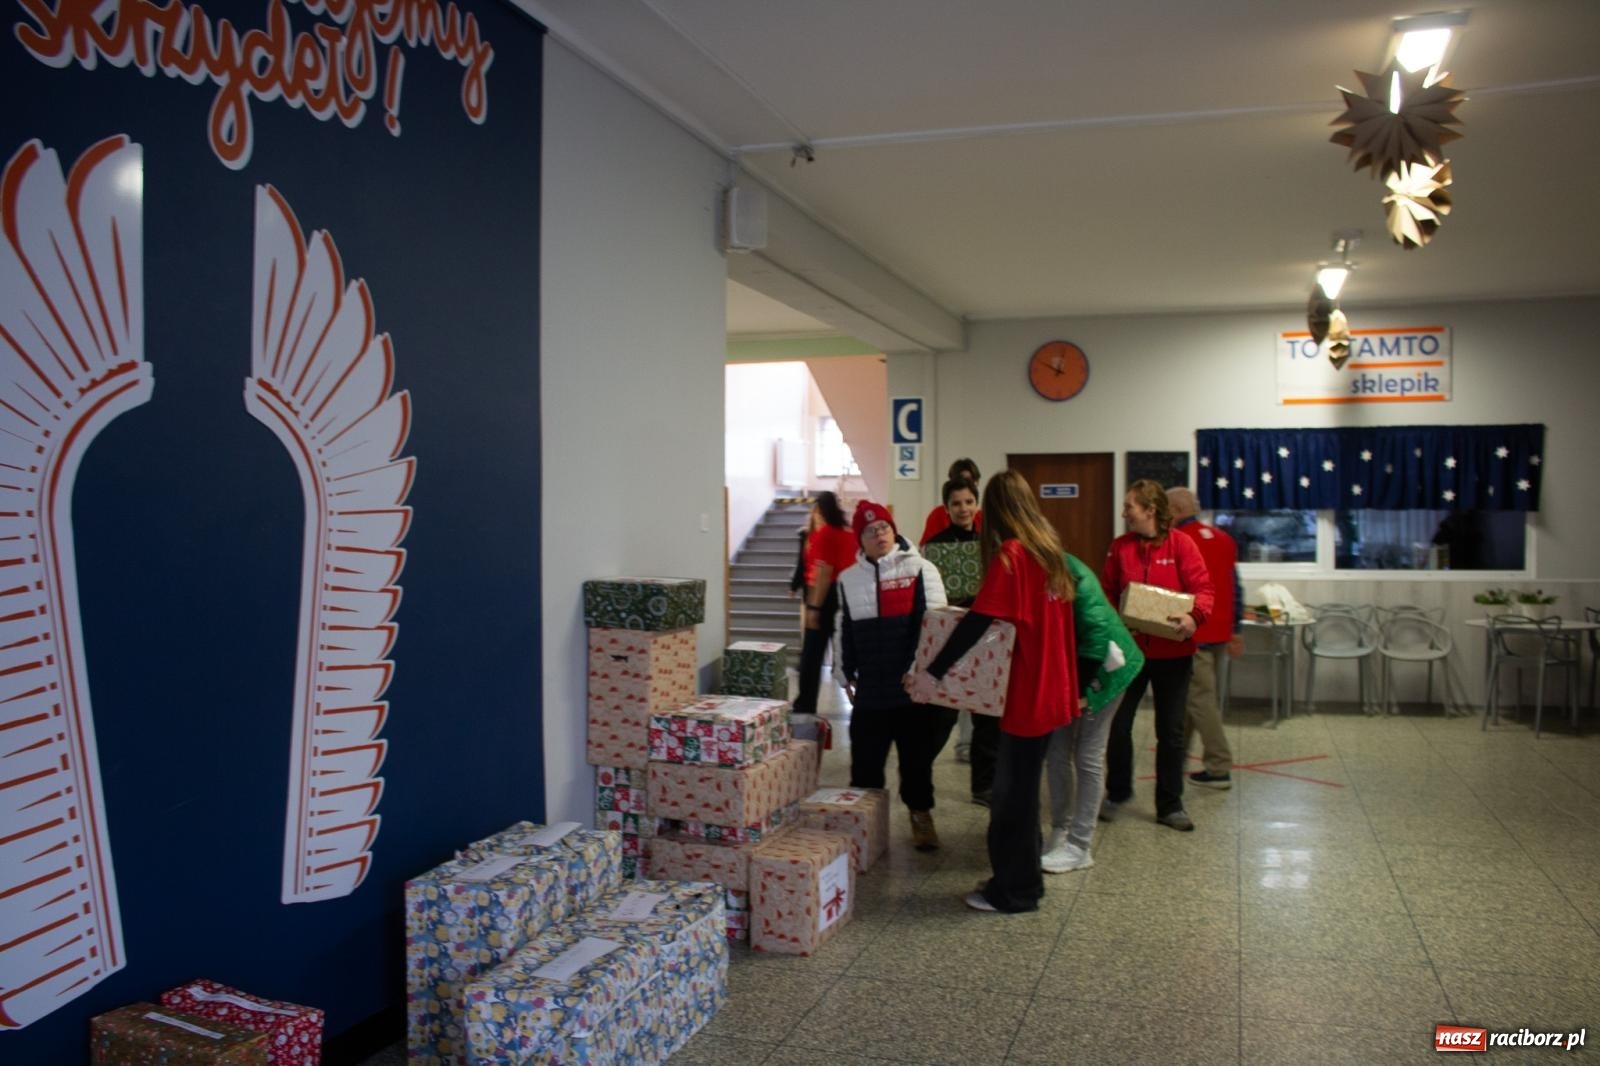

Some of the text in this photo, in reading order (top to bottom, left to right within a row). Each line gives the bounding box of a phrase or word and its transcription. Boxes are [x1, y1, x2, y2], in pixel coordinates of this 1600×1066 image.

[1286, 340, 1320, 359] TO
[1351, 372, 1440, 396] sklepik
[897, 402, 919, 441] C
